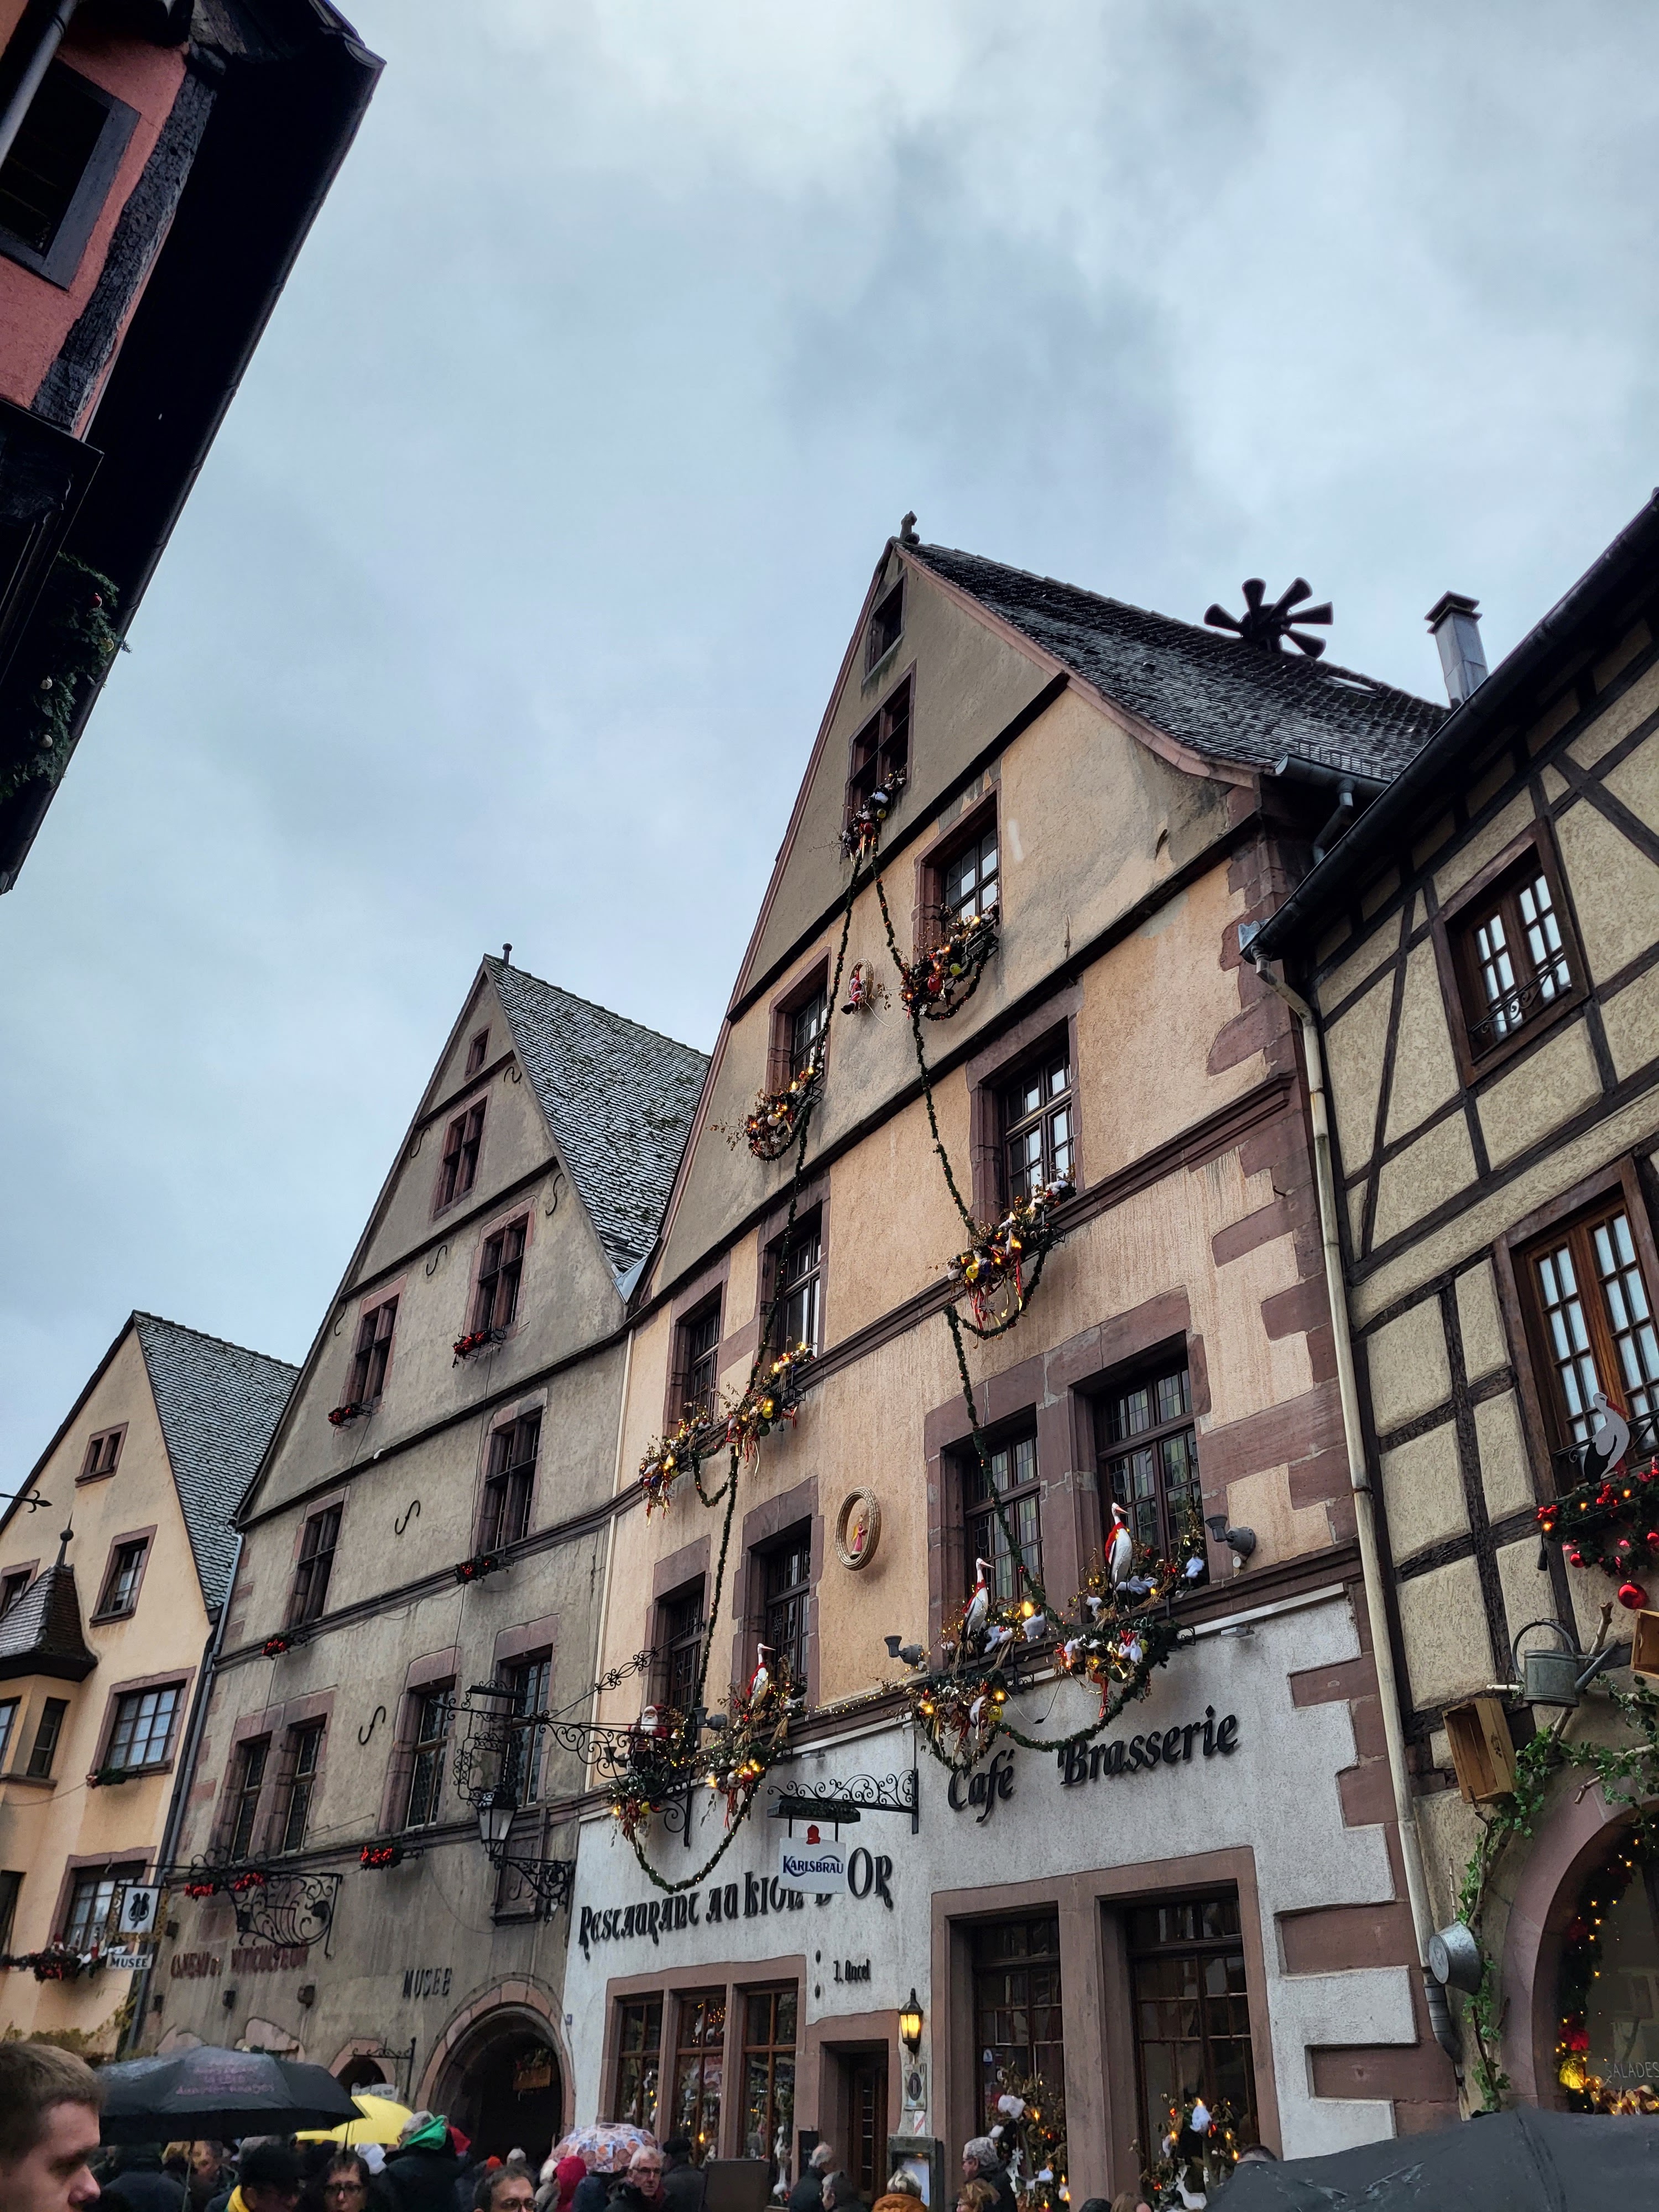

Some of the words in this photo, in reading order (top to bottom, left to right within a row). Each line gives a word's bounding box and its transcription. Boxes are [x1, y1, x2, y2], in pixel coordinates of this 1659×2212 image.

[948, 1749, 1015, 1823] Café
[1057, 1704, 1238, 1786] Brasserie
[783, 1855, 843, 1877] KARLSBRÄU
